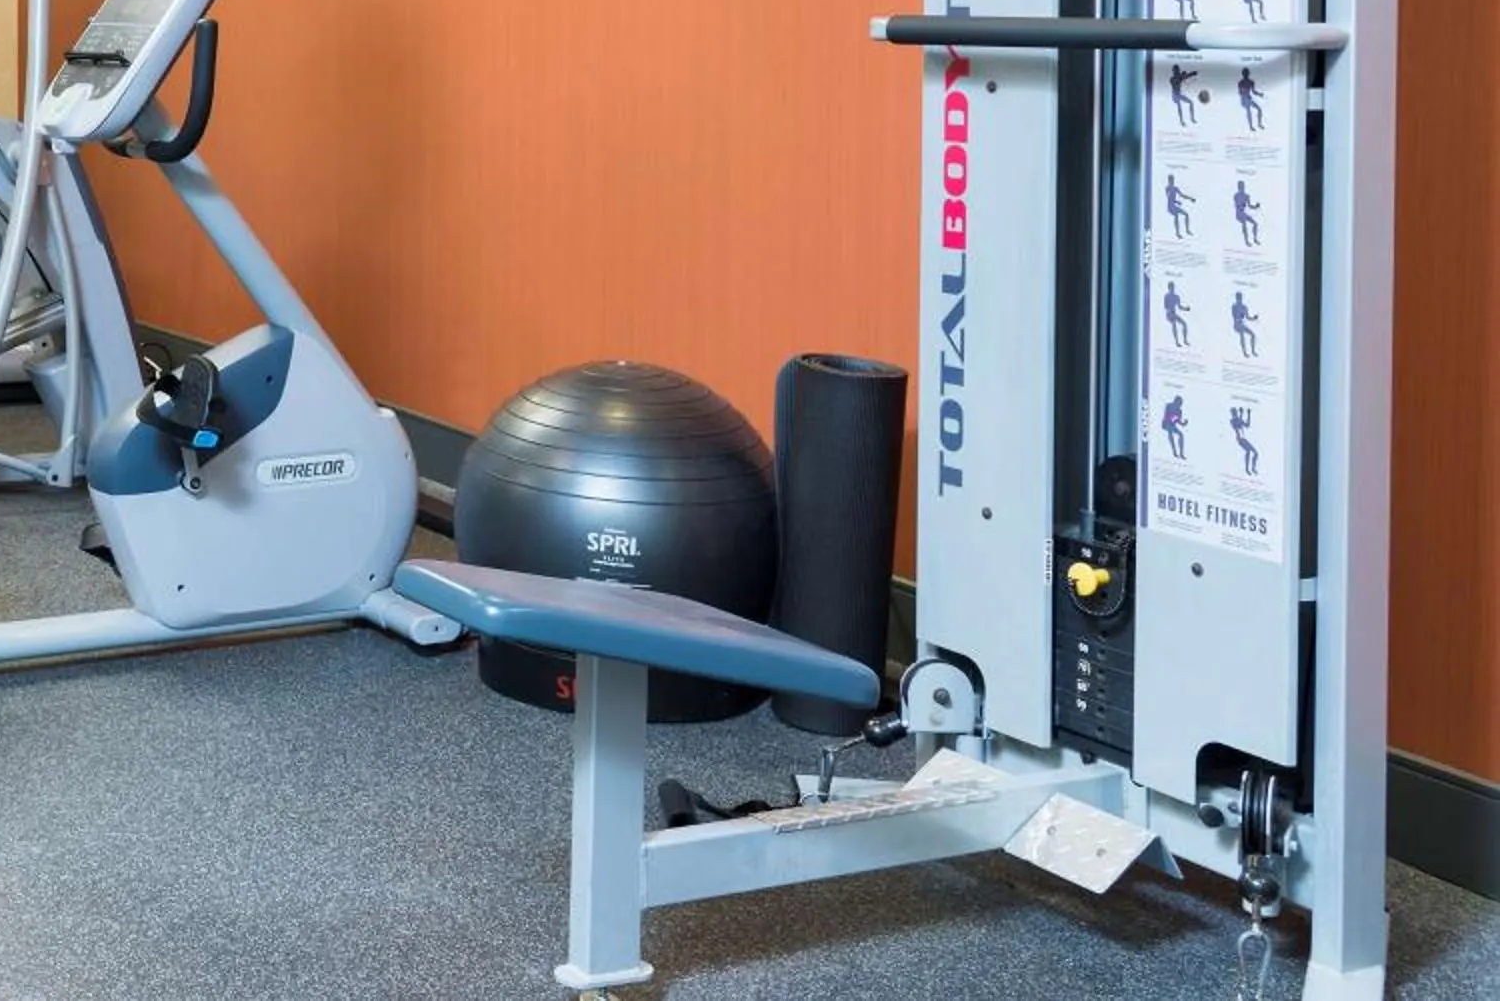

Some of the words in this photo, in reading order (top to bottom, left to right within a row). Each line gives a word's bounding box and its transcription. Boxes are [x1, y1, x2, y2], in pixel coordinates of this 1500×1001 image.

[942, 45, 971, 251] BODY
[938, 252, 968, 497] TOTAL
[281, 459, 345, 480] PRECOR
[1156, 492, 1201, 518] HOTEL
[1205, 503, 1268, 535] FITNESS
[586, 532, 638, 556] SPRI
[556, 675, 578, 698] S
